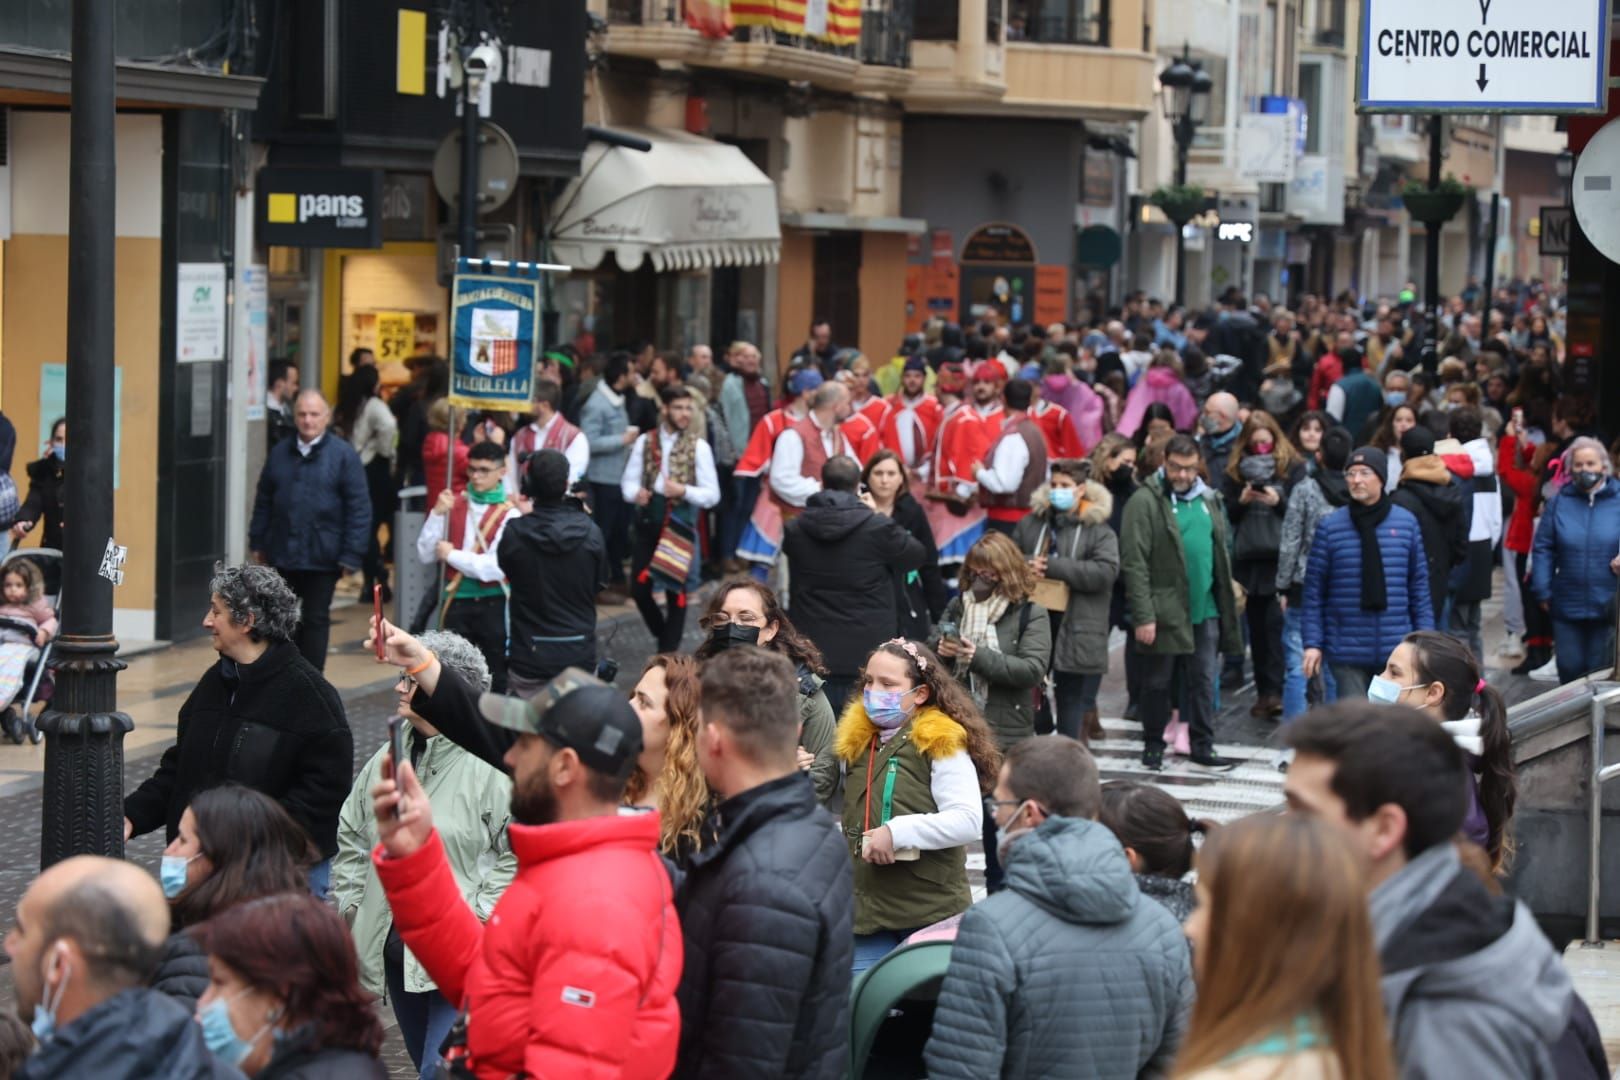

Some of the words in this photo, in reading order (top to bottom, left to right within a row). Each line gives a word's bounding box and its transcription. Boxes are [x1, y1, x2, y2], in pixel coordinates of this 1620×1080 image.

[1478, 0, 1491, 25] Y
[1377, 29, 1460, 57] CENTRO
[1467, 30, 1591, 58] COMERCIAL
[299, 193, 364, 223] pans
